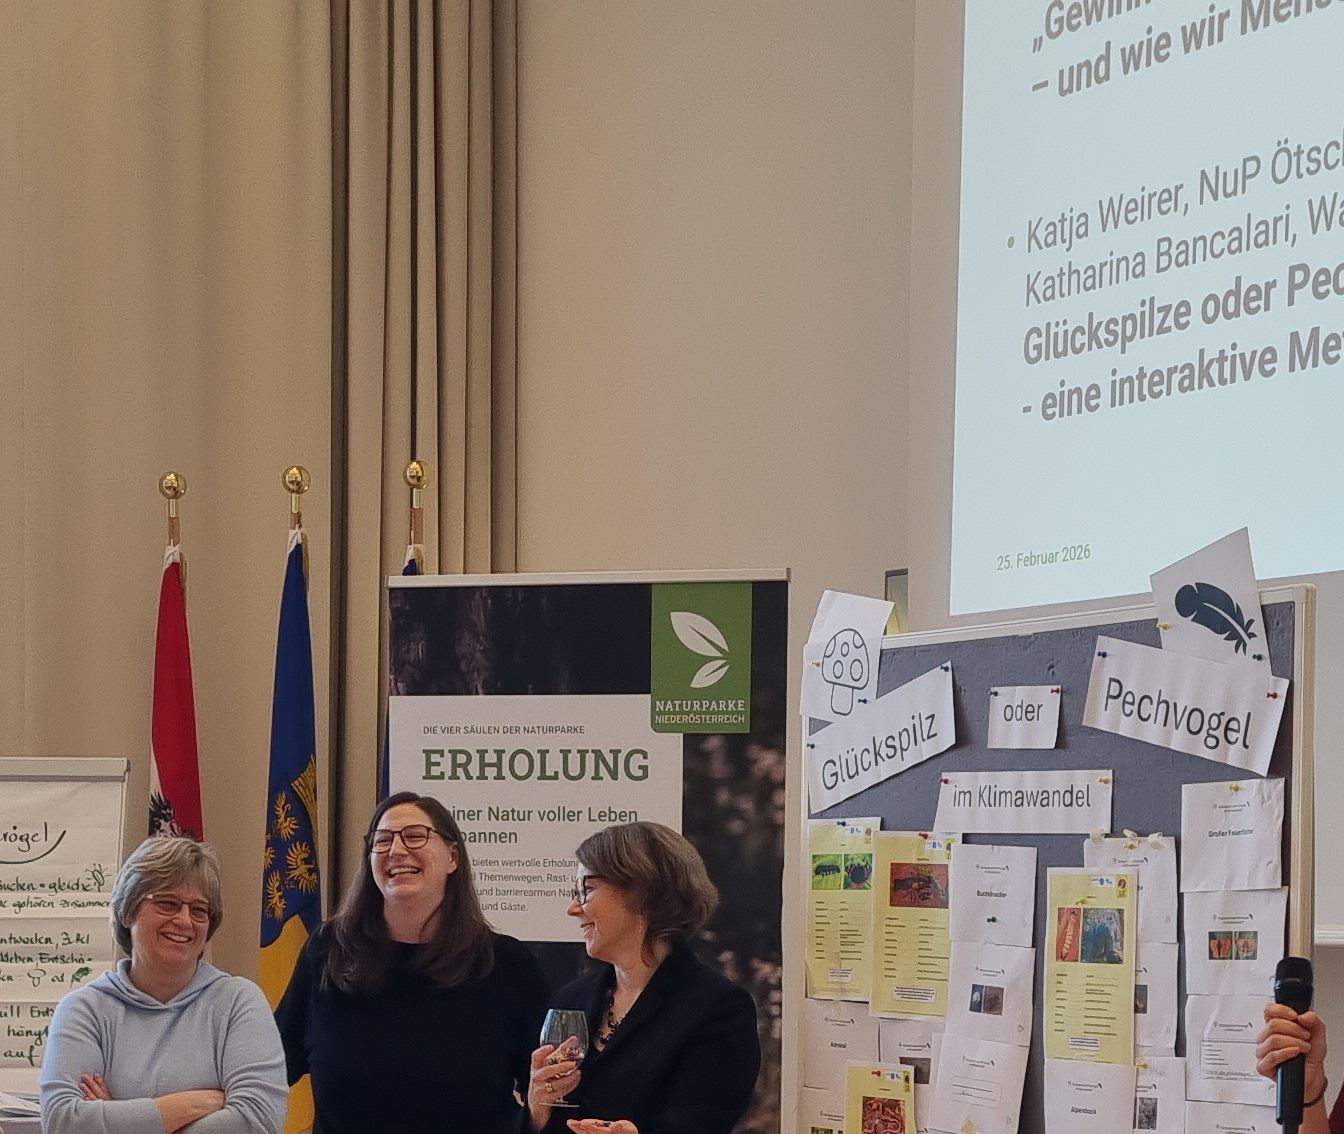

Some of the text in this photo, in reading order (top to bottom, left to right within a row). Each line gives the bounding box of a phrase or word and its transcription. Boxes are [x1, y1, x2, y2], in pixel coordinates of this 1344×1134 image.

[1058, 40, 1111, 97] und
[1120, 26, 1171, 76] wie
[1181, 4, 1231, 54] wir
[1027, 207, 1090, 254] Katja
[1099, 182, 1189, 233] Weirer,
[1199, 155, 1262, 205] NuP
[1025, 250, 1146, 307] Katharina
[1156, 204, 1297, 274] Bancalari,
[1023, 296, 1191, 365] Glückspilze
[1201, 277, 1277, 325] oder
[1041, 380, 1101, 421] eine
[1110, 342, 1278, 408] interaktive
[997, 544, 1091, 570] 25. Februar 2026
[656, 700, 745, 711] NATURPARKE
[1003, 700, 1043, 722] oder
[1104, 677, 1251, 750] Pechvogel
[423, 725, 585, 735] DIE VIER SÄULEN DER NATURPARKE
[655, 714, 744, 724] NIEDERÖSTERREICH
[822, 713, 938, 790] Glückspilz
[422, 748, 649, 781] ERHOLUNG
[953, 784, 1090, 808] im Klimawandel
[448, 806, 638, 822] iner Natur voller Leben
[472, 858, 499, 867] bieten
[501, 858, 541, 867] wertvolle
[479, 873, 545, 883] Themenwegen,
[547, 873, 569, 882] Rast-
[477, 887, 493, 896] und
[496, 887, 556, 897] barrierearmen
[482, 902, 528, 911] und Gäste.
